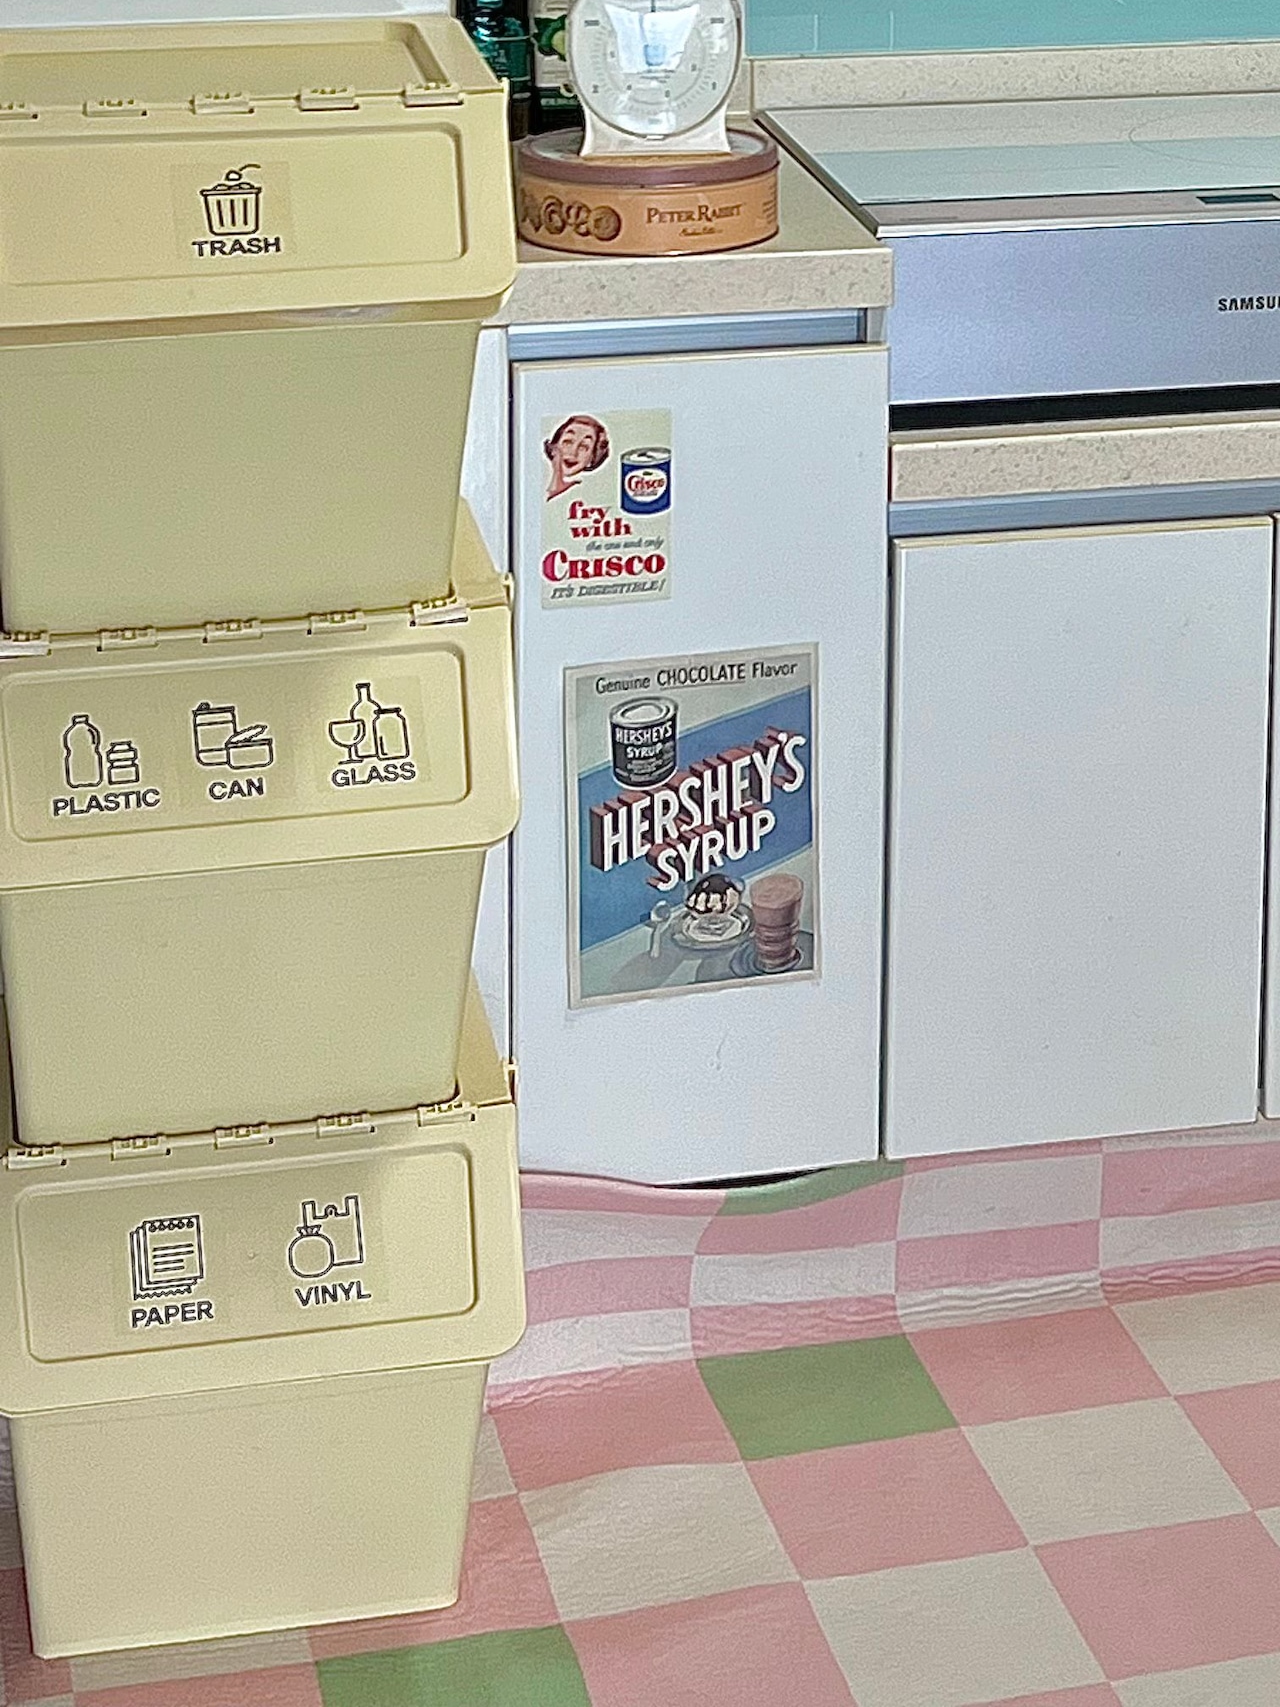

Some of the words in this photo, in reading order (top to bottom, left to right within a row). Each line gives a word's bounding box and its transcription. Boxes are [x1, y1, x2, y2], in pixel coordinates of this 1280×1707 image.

[646, 206, 695, 224] PETER
[697, 203, 743, 223] RABBIT
[191, 237, 281, 257] TRASH
[627, 474, 665, 493] Crisco
[567, 500, 612, 522] fry
[570, 517, 632, 538] with
[623, 537, 642, 549] and
[644, 535, 665, 551] only
[542, 549, 666, 582] CRISCO
[550, 583, 575, 600] IT'S
[577, 578, 667, 598] DIGESTIBLE!
[596, 675, 650, 694] Genuine
[656, 663, 746, 687] CHOCOLATE
[752, 661, 798, 679] Flavor
[626, 742, 663, 758] SYRUP
[331, 762, 417, 788] GLASS
[208, 777, 265, 801] CAN
[597, 729, 807, 872] HERSHEY'S
[52, 788, 161, 817] PLASTIC
[655, 808, 776, 892] SYRUP
[294, 1280, 372, 1307] VINYL
[131, 1300, 215, 1328] PAPER
